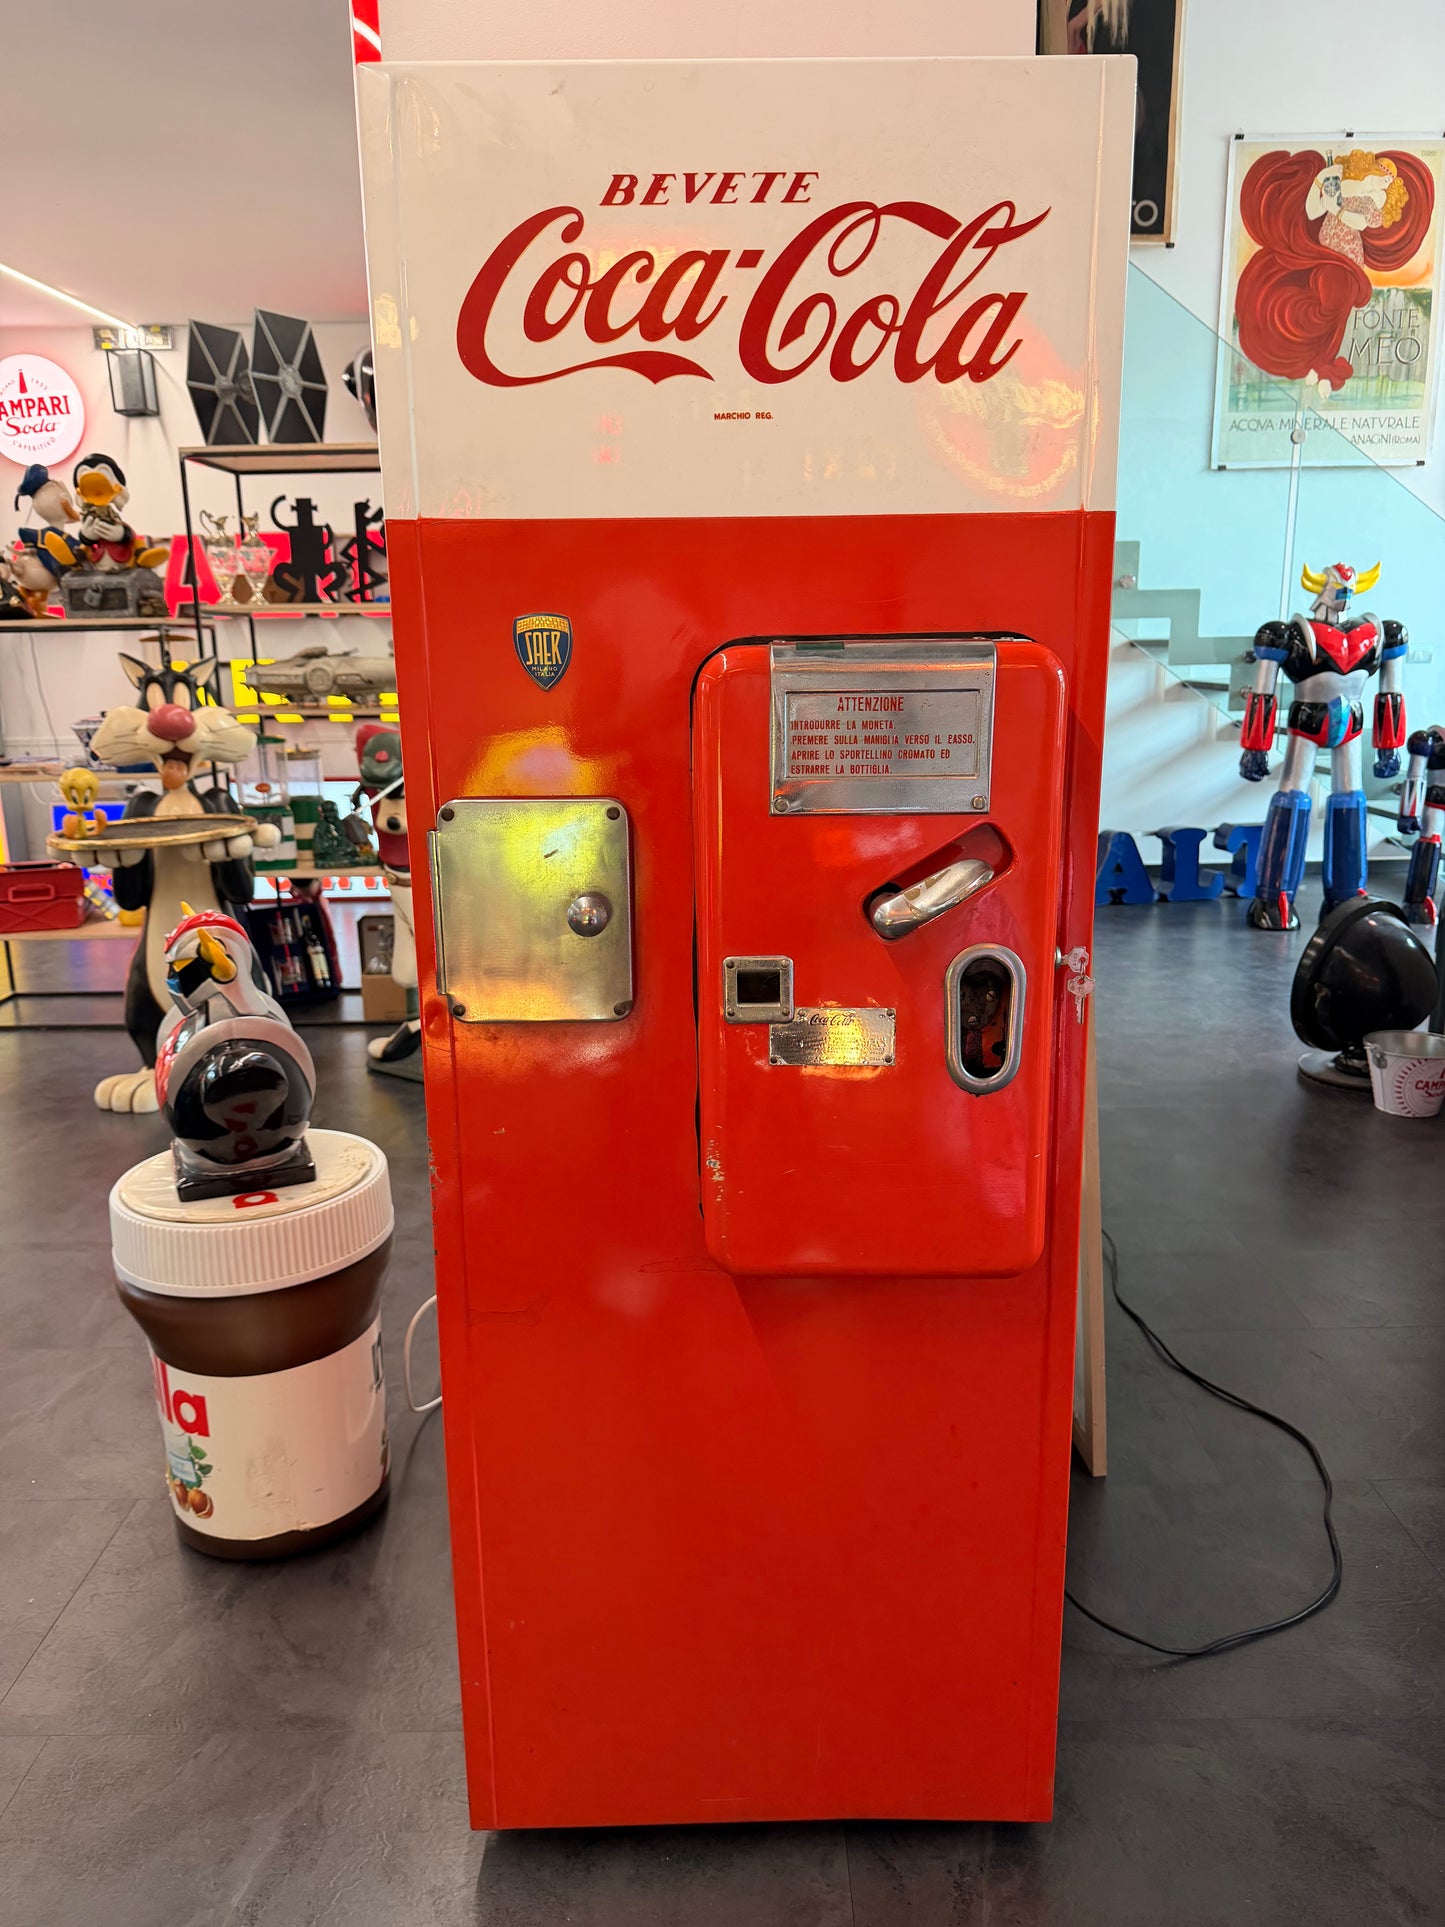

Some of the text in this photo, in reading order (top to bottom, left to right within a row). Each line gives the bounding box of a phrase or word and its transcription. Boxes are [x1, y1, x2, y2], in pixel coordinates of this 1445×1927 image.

[599, 172, 819, 206] BEVETE
[456, 200, 1052, 387] Coca-Cola
[1353, 309, 1420, 330] FONTE
[1349, 335, 1422, 366] MEO
[714, 412, 774, 421] MARCHIO REG.
[3, 417, 56, 437] Soda
[525, 631, 562, 666] SAER
[837, 696, 904, 712] ATTENZIONE
[791, 720, 841, 731] INTRODURRE
[846, 720, 857, 730] LA
[834, 735, 858, 745] SULLA
[863, 735, 899, 745] MANIGLIA
[905, 734, 929, 745] VERSO
[934, 734, 942, 745] IL
[791, 749, 950, 761] APRIRE LO SPORTELLINO CROMATO ED
[791, 764, 892, 775] ESTRARRE LA BOTTIGLIA.
